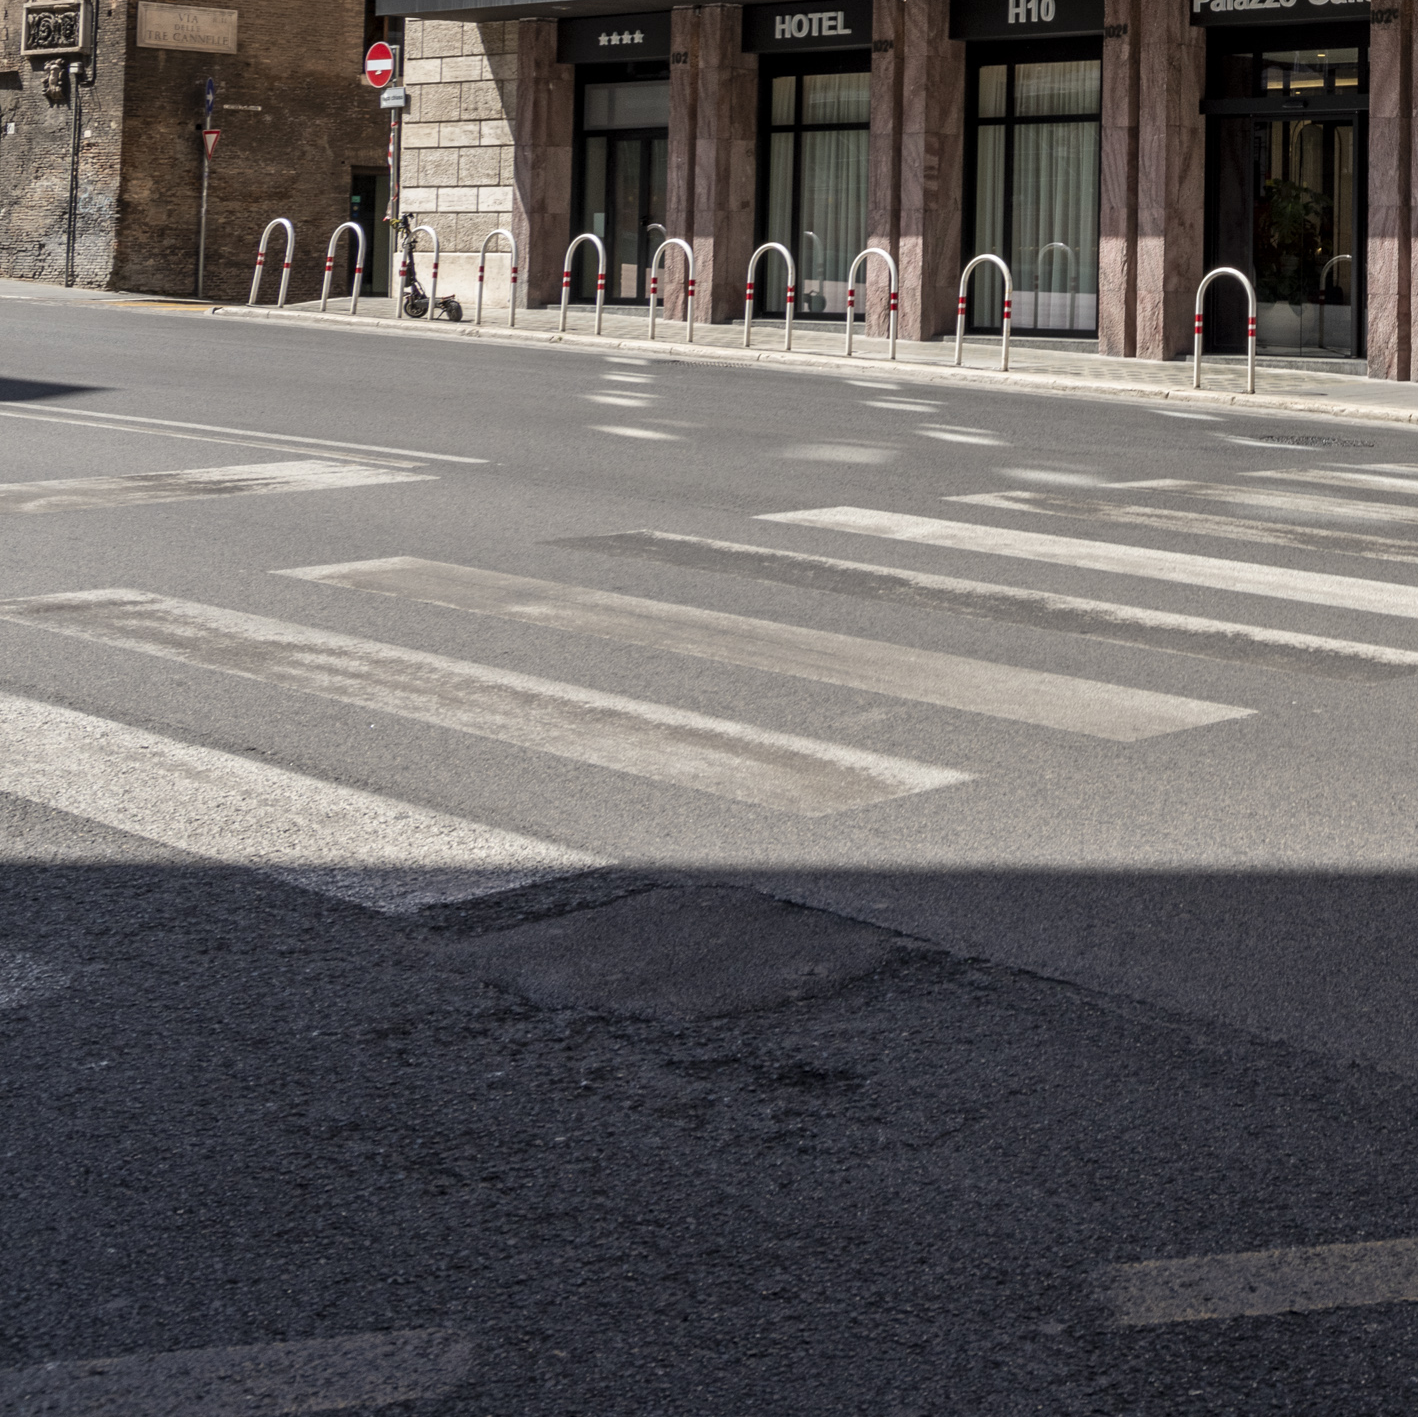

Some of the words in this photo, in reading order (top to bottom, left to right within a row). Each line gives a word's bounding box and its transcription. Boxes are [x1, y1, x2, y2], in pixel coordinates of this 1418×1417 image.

[178, 13, 199, 24] VIA
[774, 11, 852, 39] HOTEL
[174, 23, 201, 33] DELLE
[147, 29, 169, 41] TRE
[172, 32, 229, 46] CANNELLE
[671, 51, 689, 65] 102
